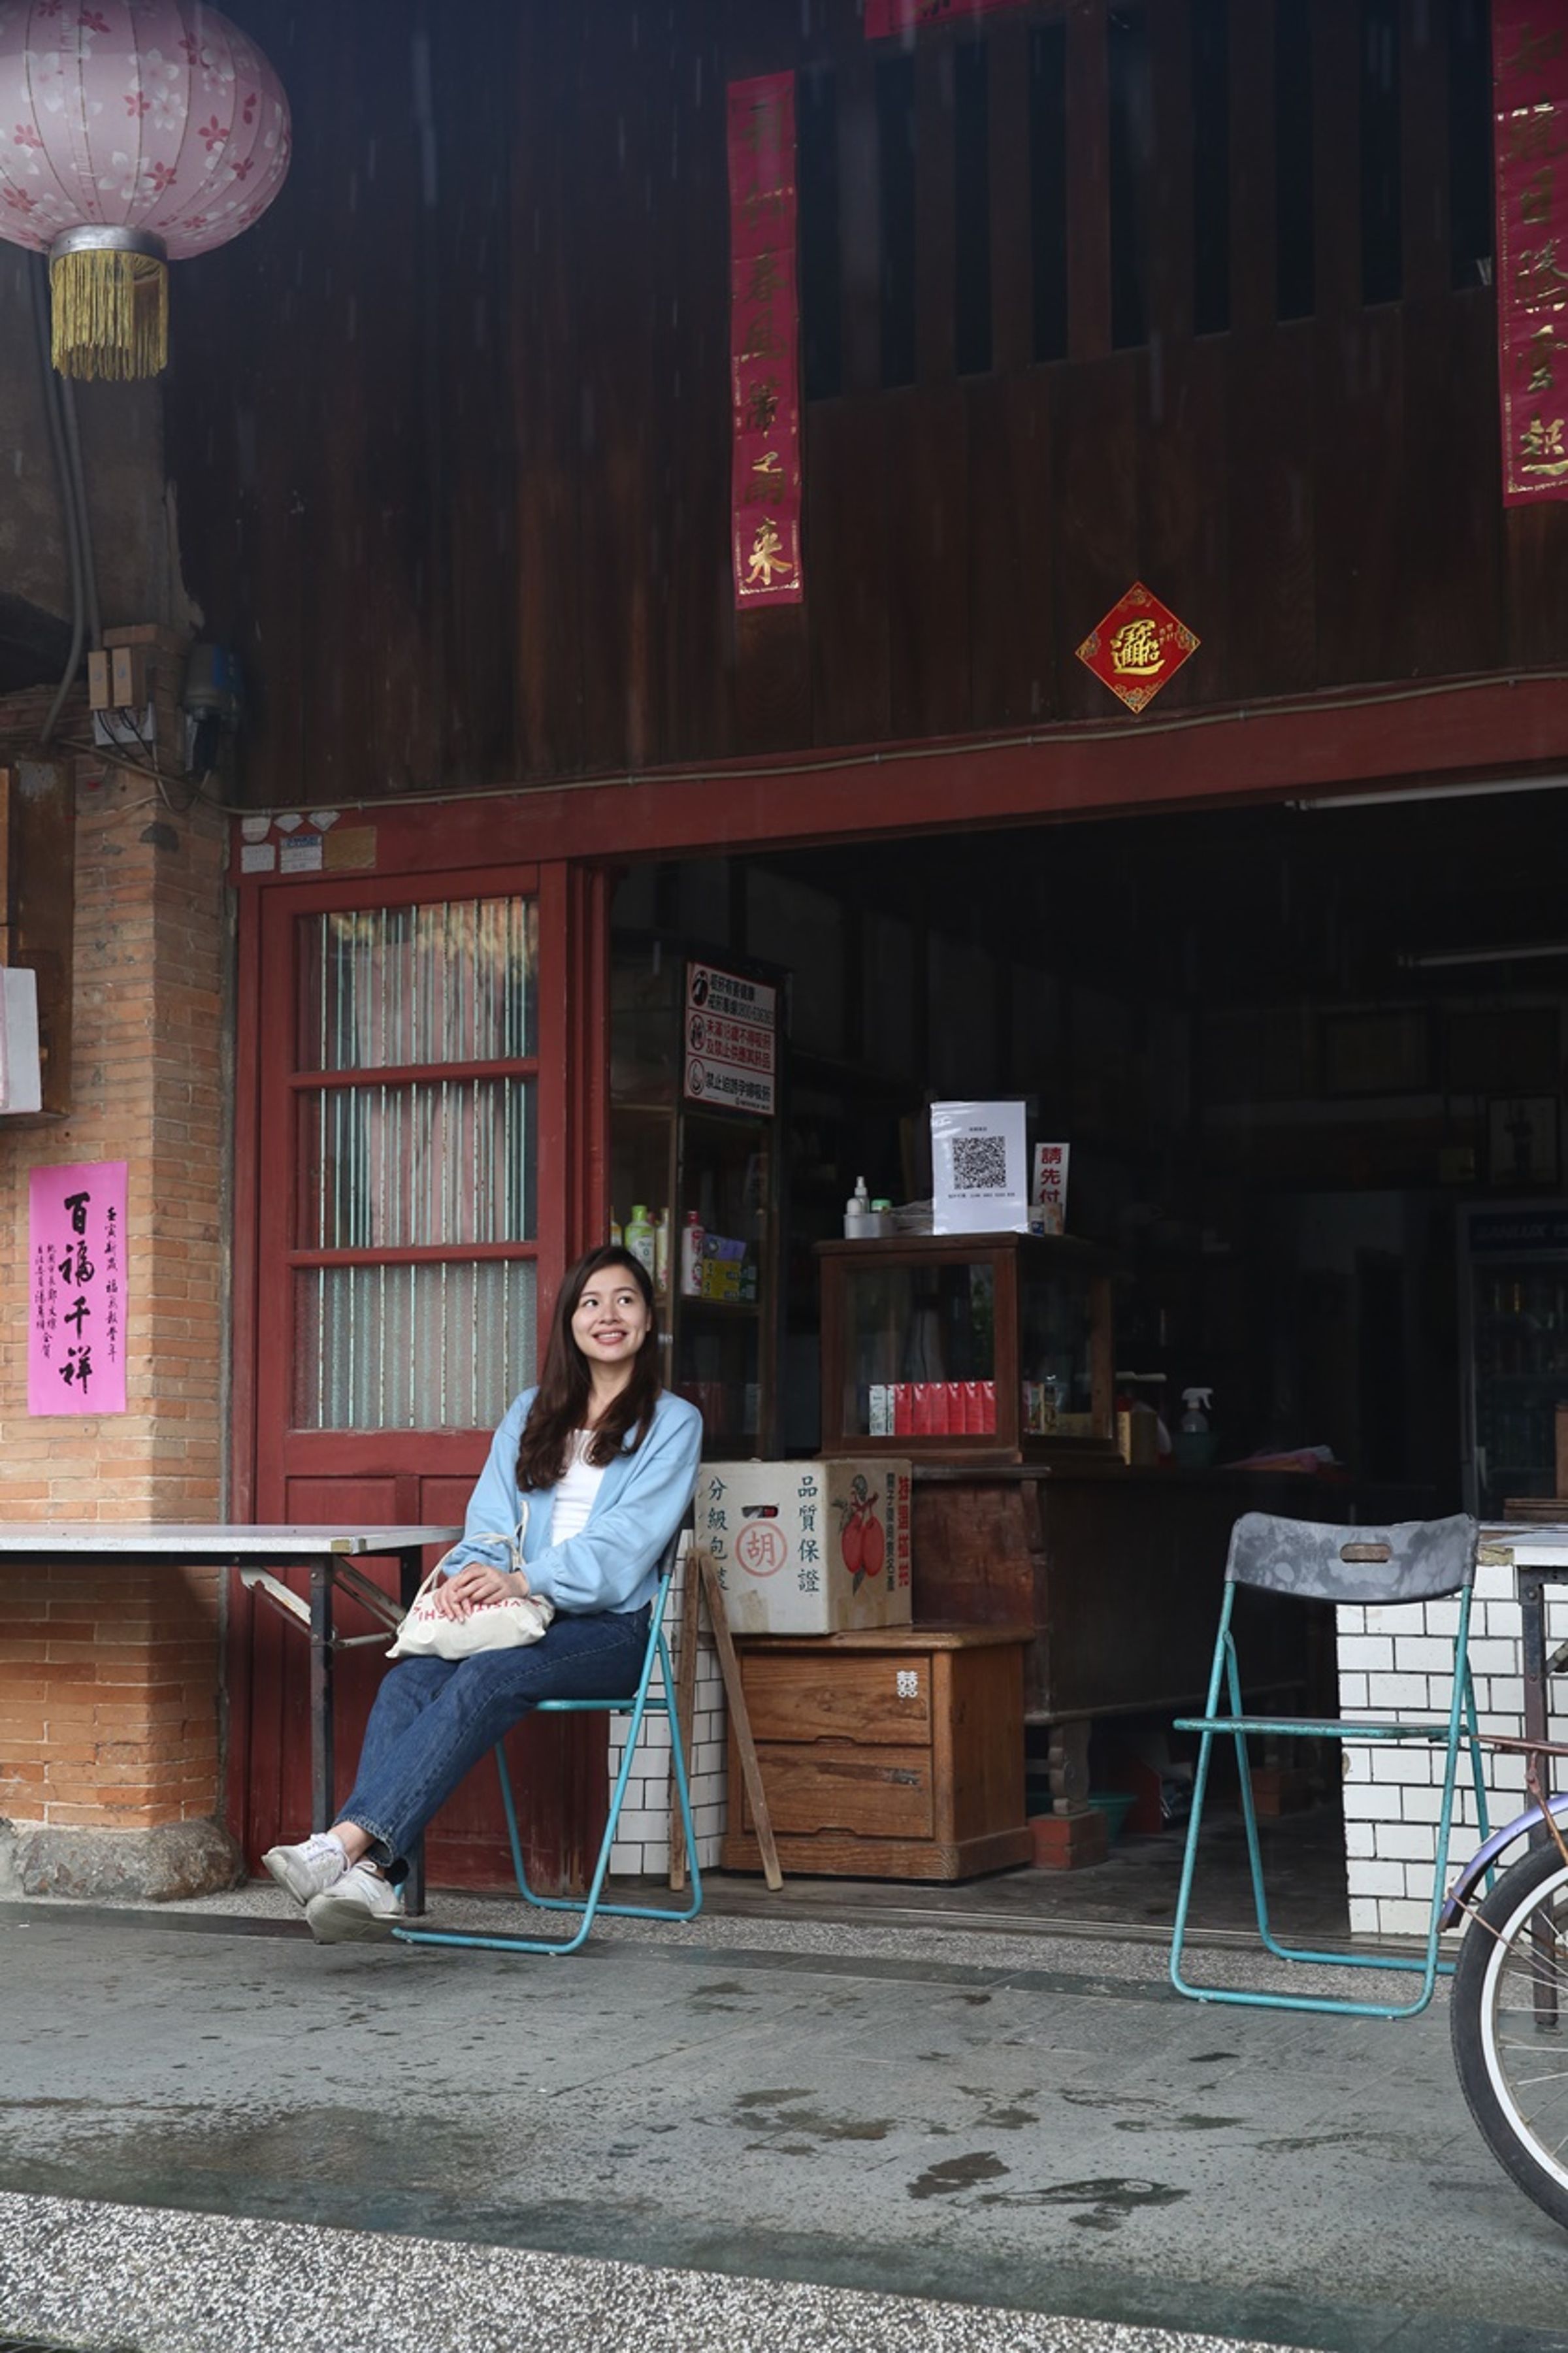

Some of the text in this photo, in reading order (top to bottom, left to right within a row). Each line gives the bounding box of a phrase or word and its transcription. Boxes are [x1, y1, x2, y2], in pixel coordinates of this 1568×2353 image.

[59, 1192, 94, 1394] 百福千祥
[746, 1530, 776, 1568] 胡
[797, 1475, 820, 1592] 品質保證
